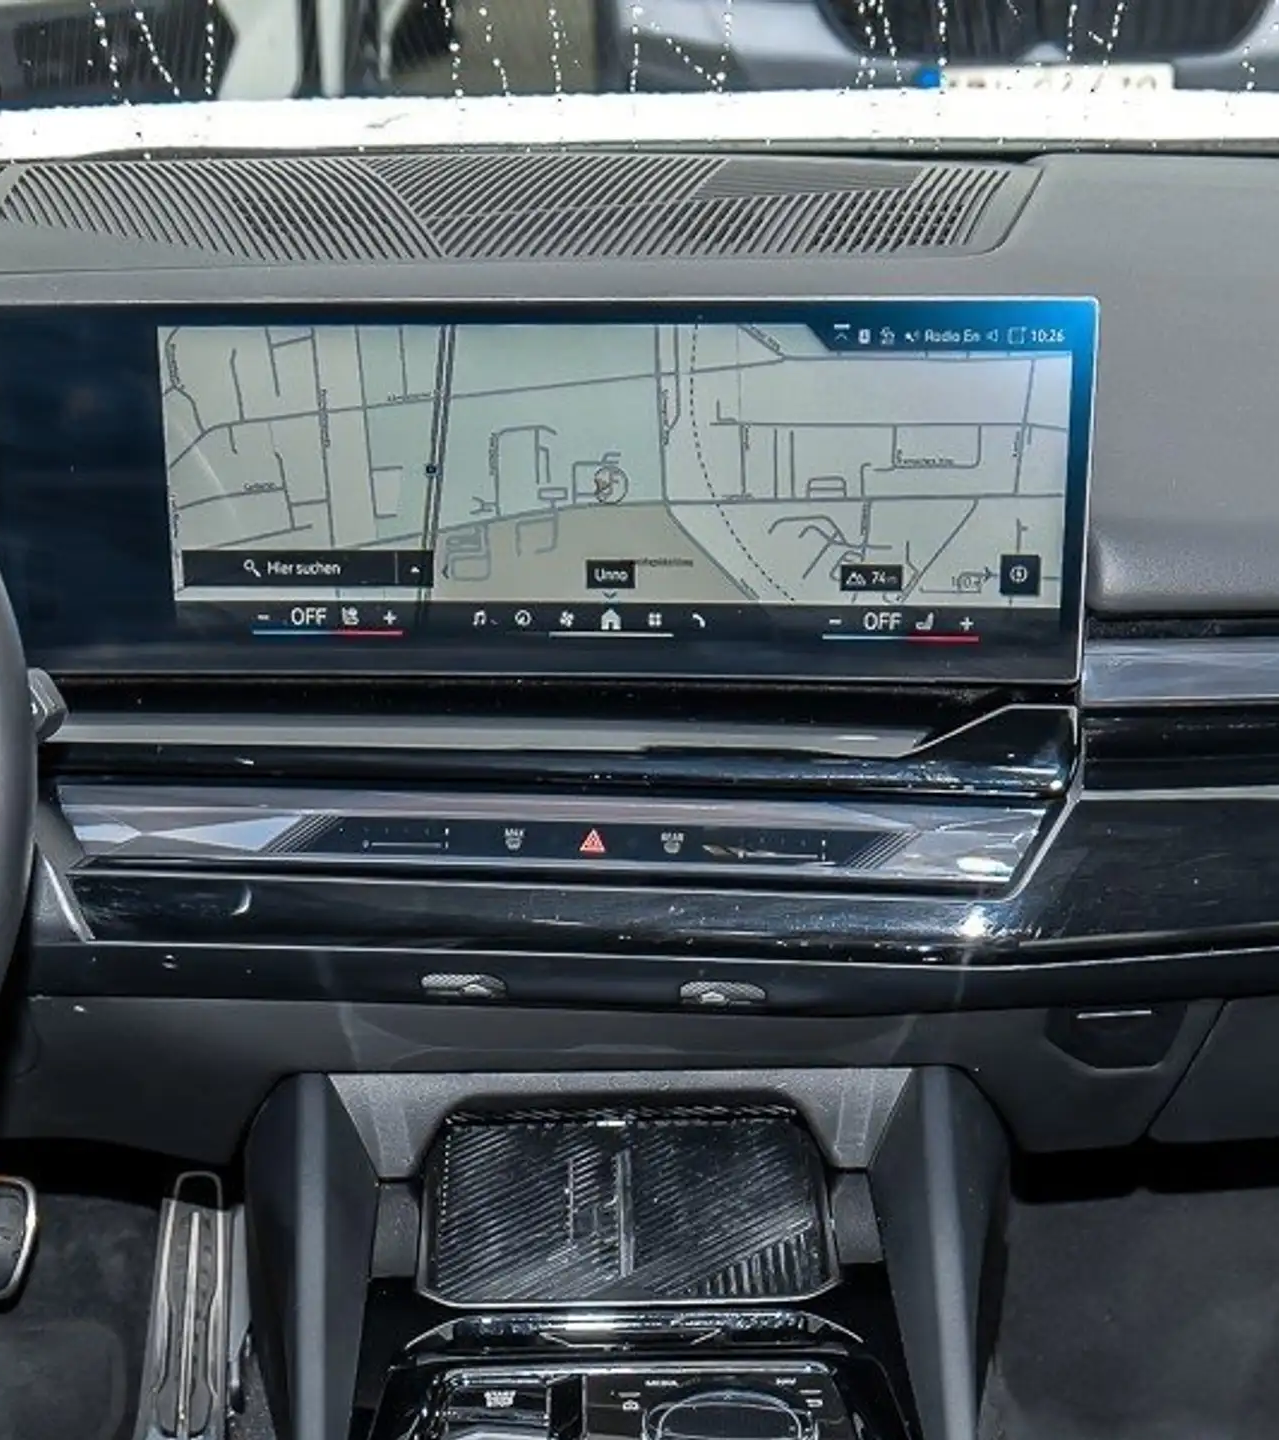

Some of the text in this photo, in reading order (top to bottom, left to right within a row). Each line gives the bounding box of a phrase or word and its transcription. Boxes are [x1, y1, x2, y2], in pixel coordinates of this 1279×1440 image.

[925, 329, 959, 343] Radio
[1031, 329, 1066, 343] 10:26
[267, 561, 341, 575] Hier suchen
[291, 607, 327, 626] OFF
[863, 612, 902, 631] OFF
